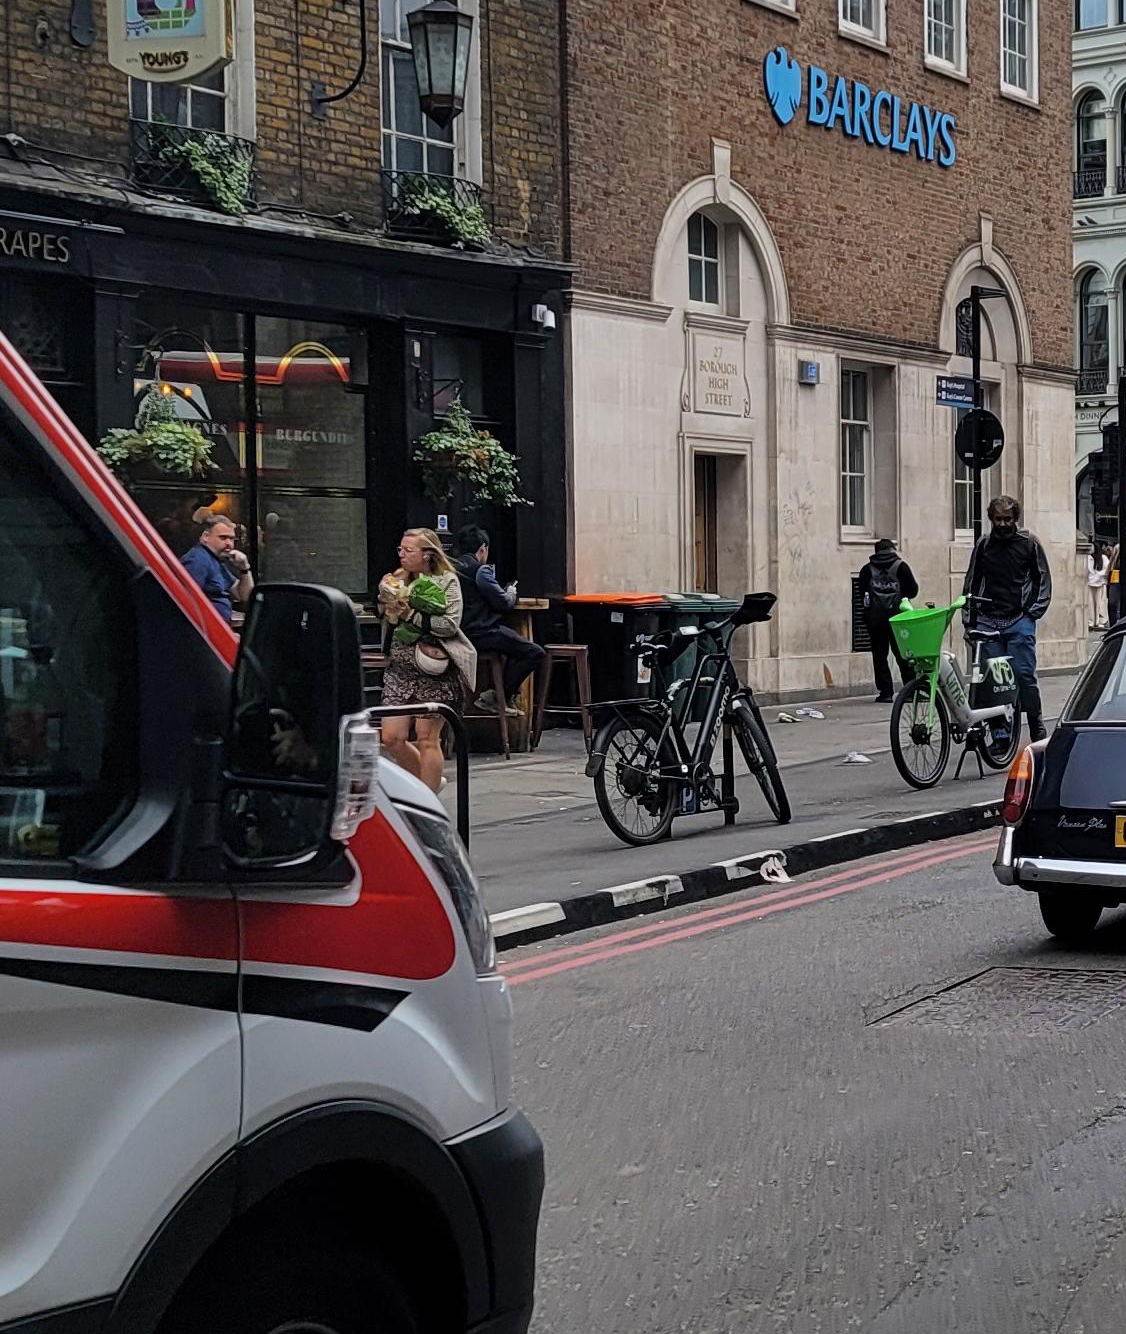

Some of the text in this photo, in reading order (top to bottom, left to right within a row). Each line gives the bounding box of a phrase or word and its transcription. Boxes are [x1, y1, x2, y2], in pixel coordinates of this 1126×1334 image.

[808, 64, 957, 168] BARCLAYS
[713, 346, 723, 358] 27
[699, 359, 738, 376] BOROUGH
[708, 377, 729, 391] HIGH
[705, 393, 732, 407] STREET
